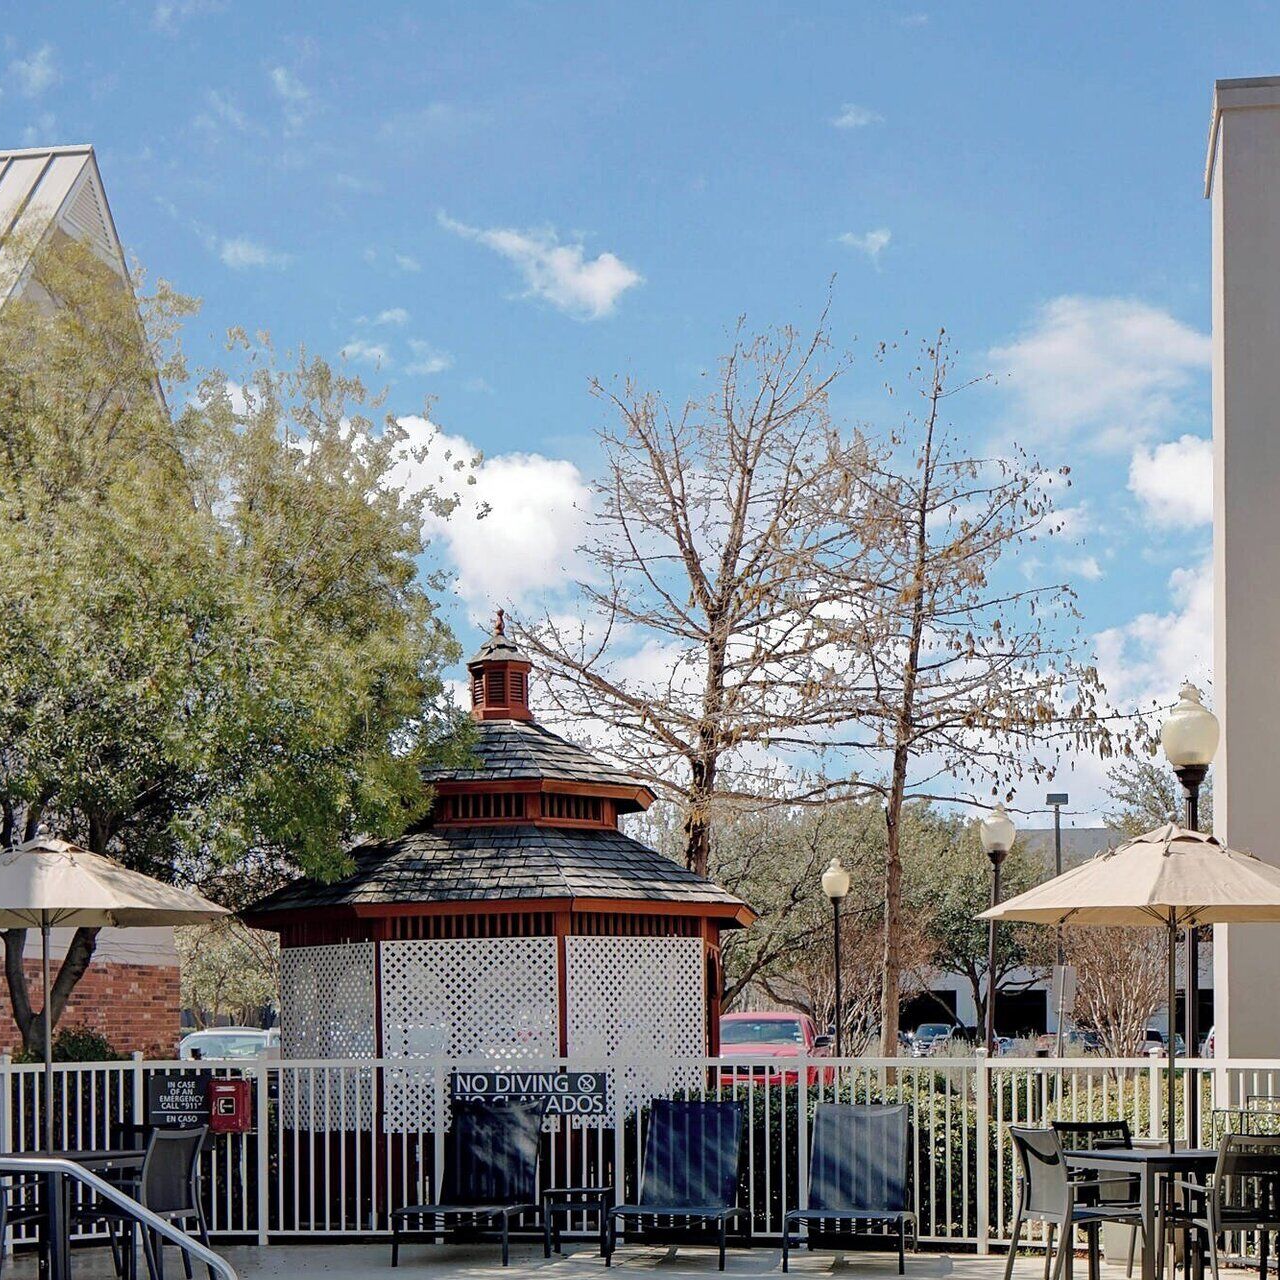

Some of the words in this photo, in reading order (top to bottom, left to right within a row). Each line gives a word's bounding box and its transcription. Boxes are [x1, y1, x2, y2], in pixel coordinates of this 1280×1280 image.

[457, 1075, 488, 1092] NO
[495, 1075, 569, 1093] DIVING
[166, 1115, 176, 1123] EN
[178, 1115, 197, 1123] CASO
